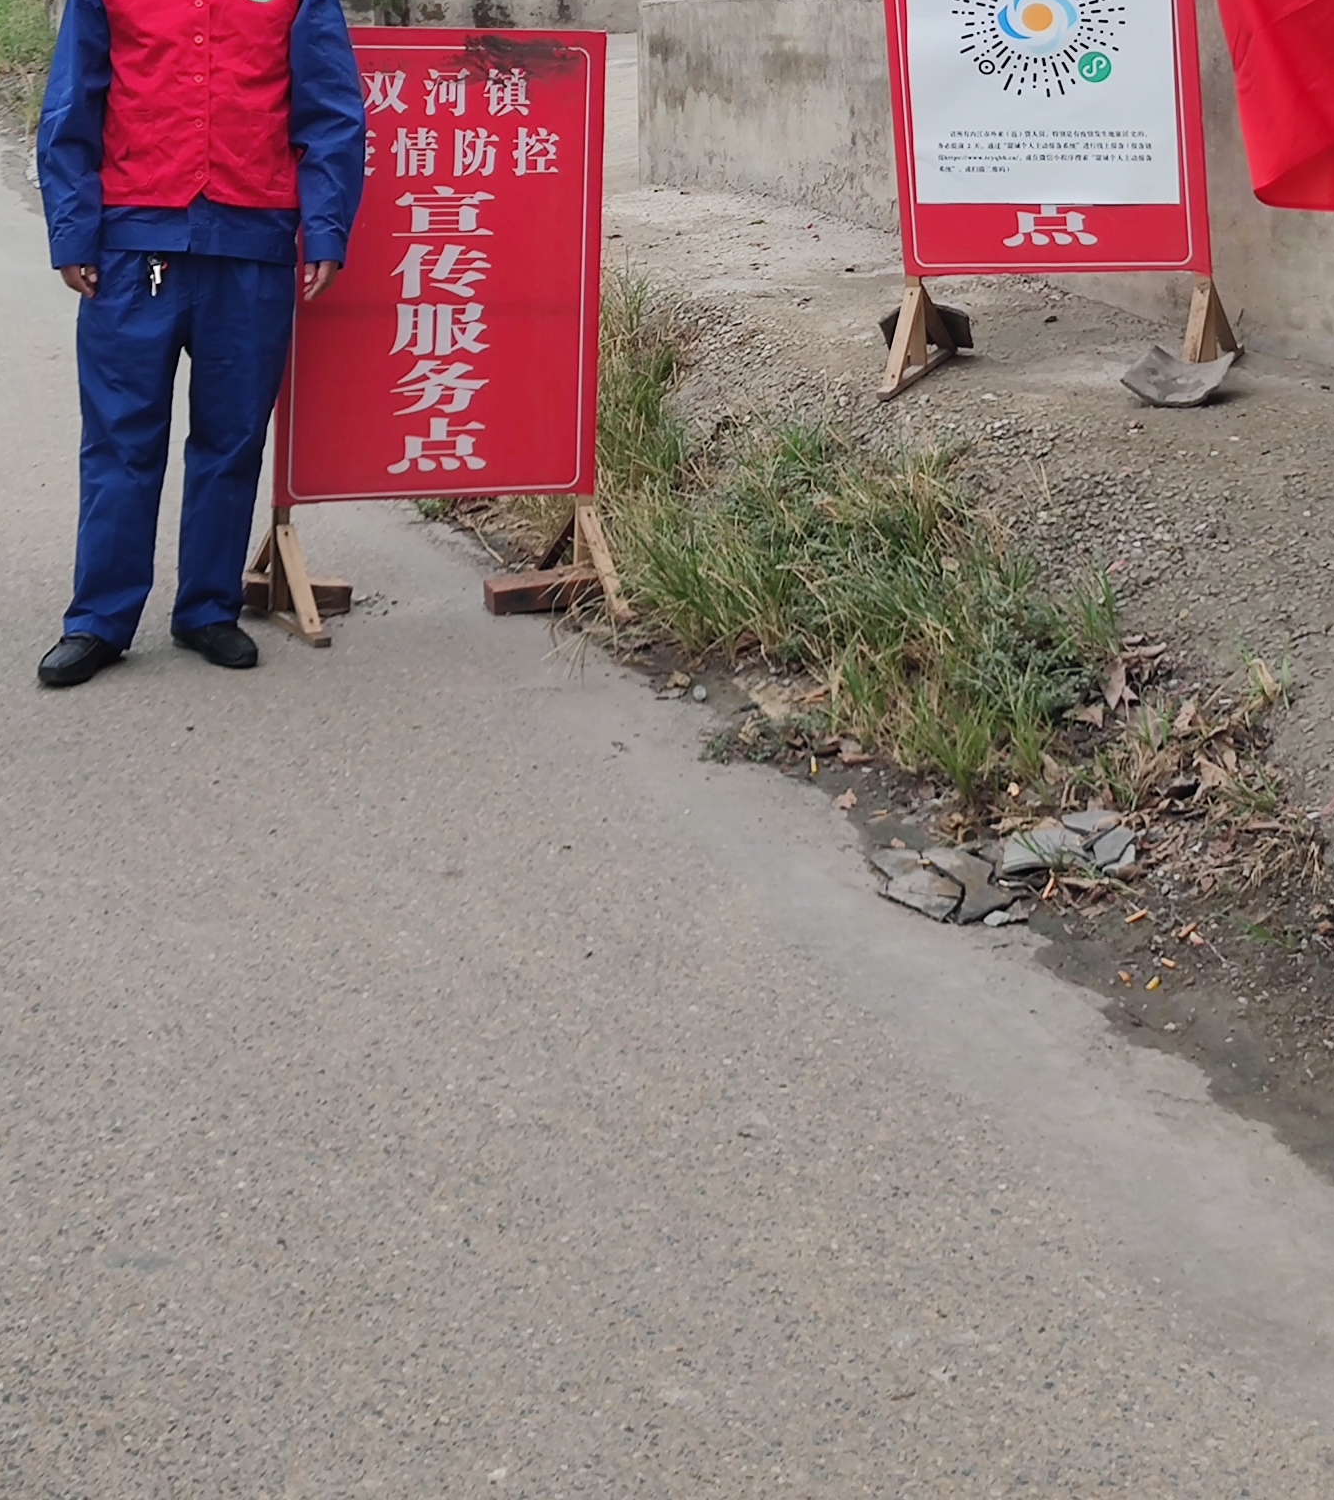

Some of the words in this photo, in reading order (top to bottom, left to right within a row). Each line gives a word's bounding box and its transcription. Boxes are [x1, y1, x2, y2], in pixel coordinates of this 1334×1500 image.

[361, 68, 531, 117] 双河镇
[364, 126, 560, 178] 情防控
[386, 185, 495, 474] 宣传服务点
